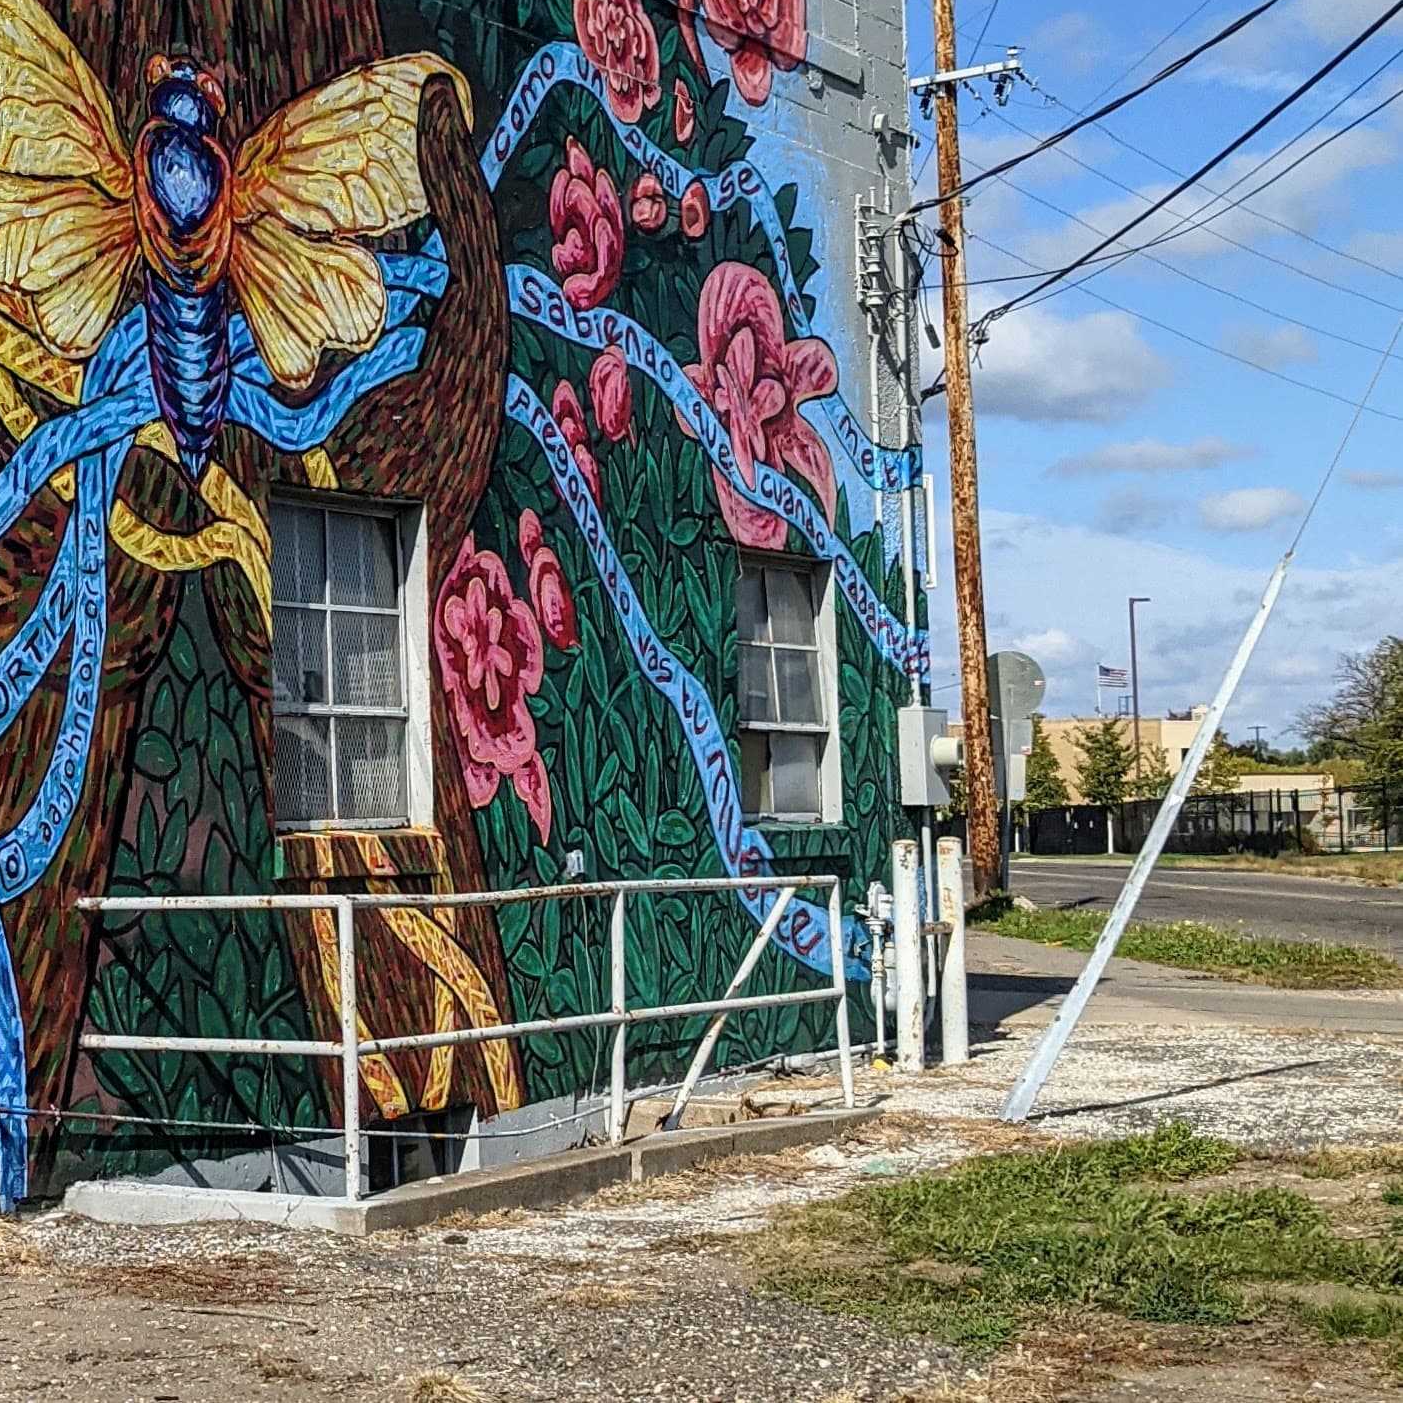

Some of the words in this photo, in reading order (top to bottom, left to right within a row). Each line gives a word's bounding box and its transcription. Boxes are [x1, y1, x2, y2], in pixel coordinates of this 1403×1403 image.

[494, 51, 555, 163] como
[716, 167, 762, 208] se
[761, 475, 826, 552] cuando
[637, 632, 673, 683] vas
[681, 678, 710, 736] tu
